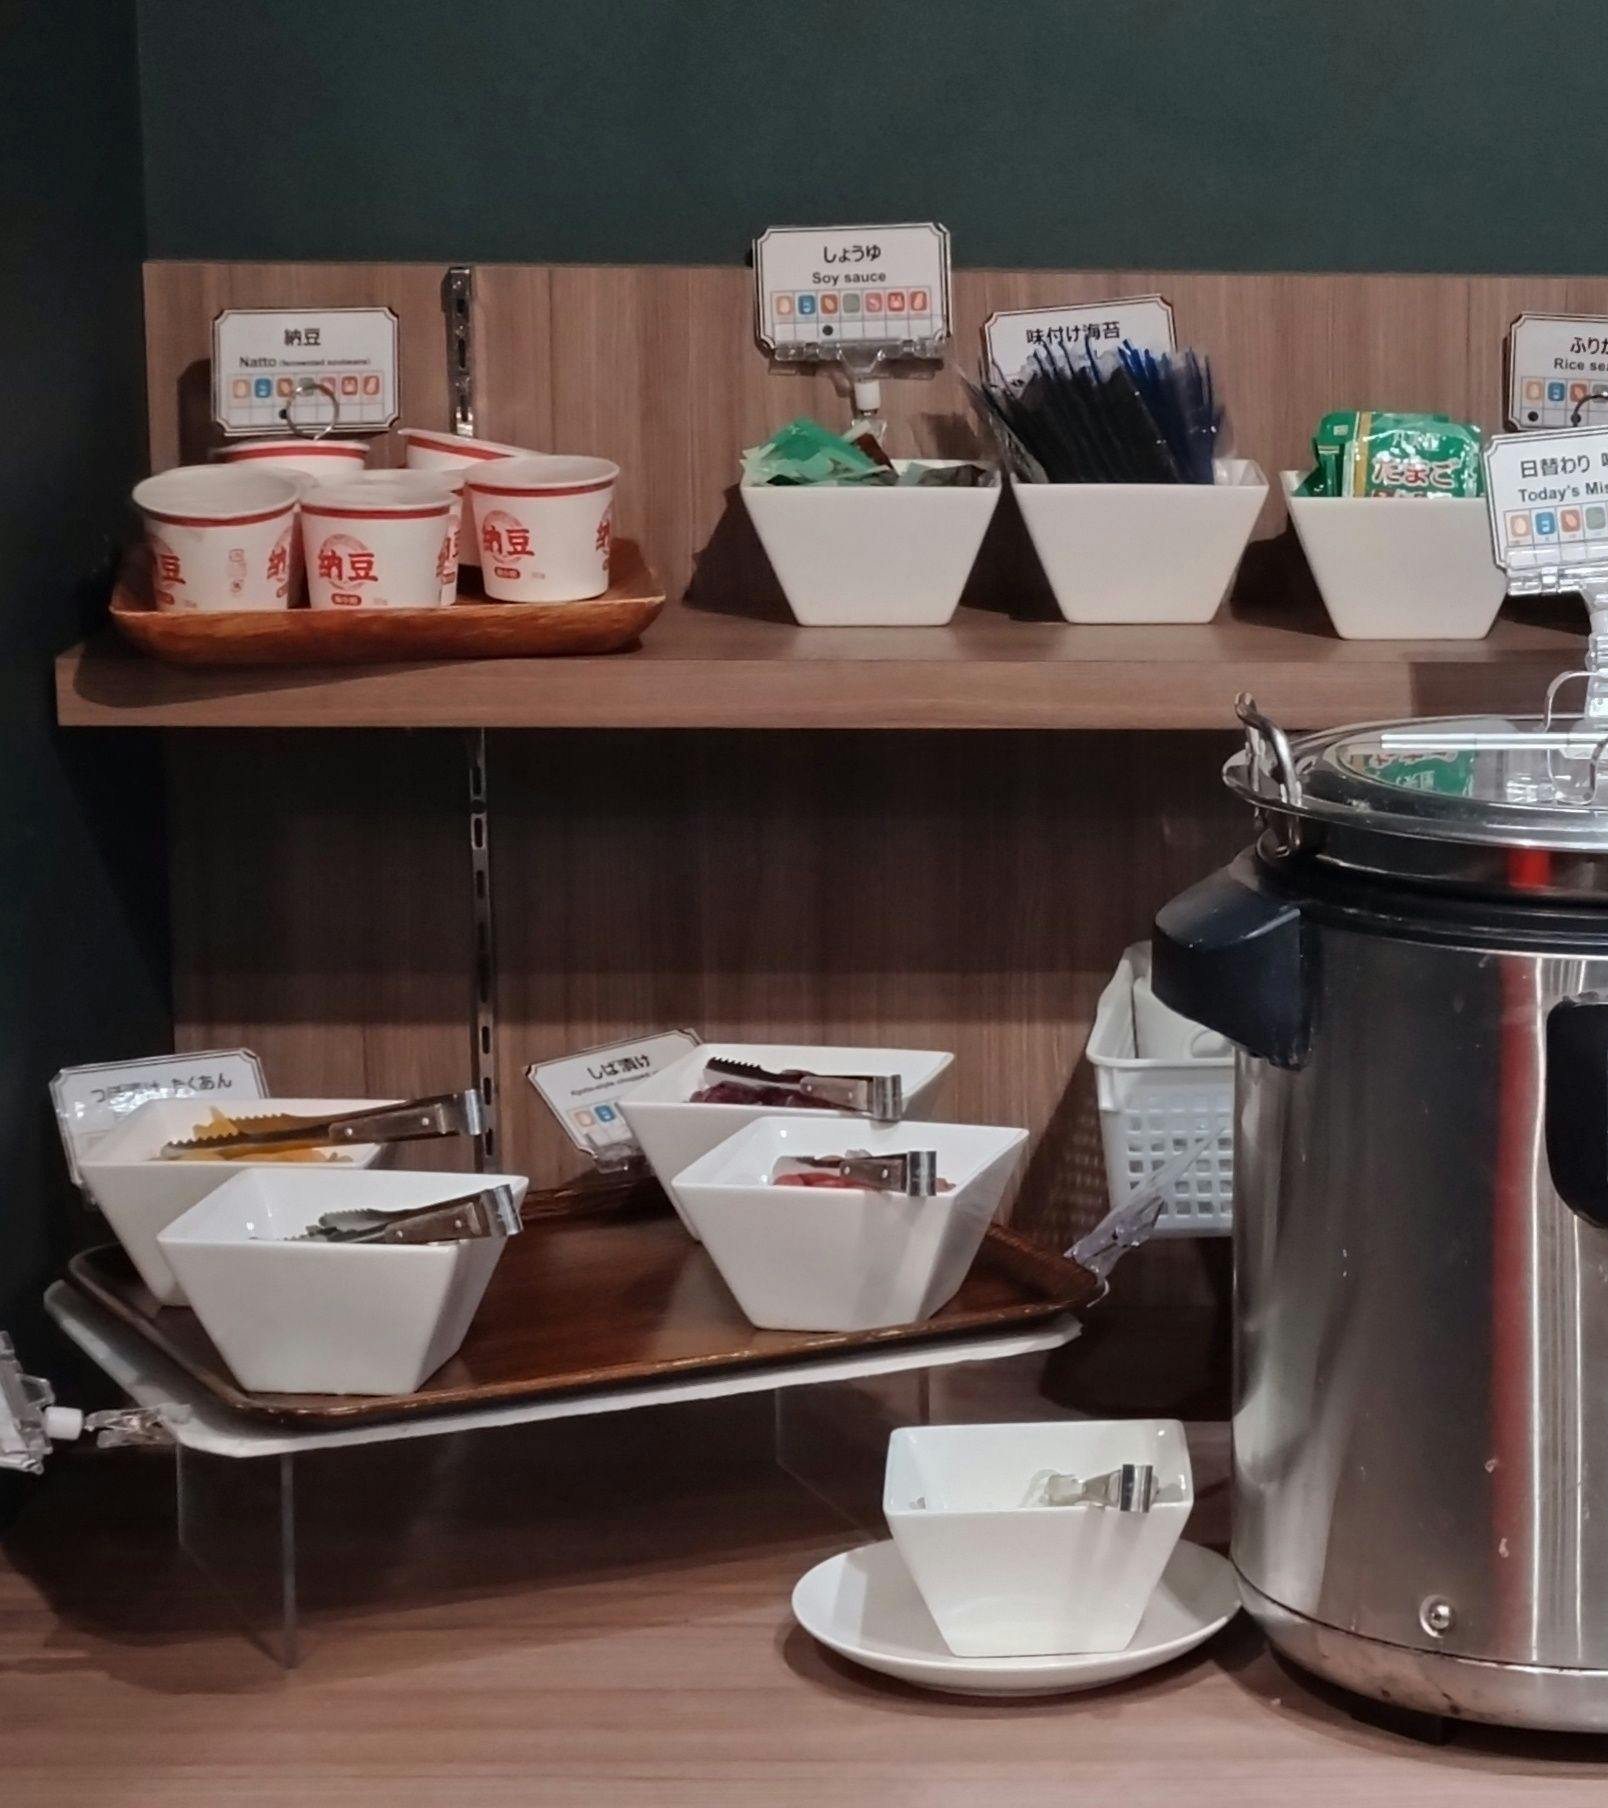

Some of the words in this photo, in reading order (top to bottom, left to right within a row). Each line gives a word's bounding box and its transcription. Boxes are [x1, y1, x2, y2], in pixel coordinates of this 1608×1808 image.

[823, 245, 882, 264] しょうゆ
[812, 272, 839, 285] Soy
[844, 271, 886, 284] sauce
[284, 328, 321, 346] 納豆
[1026, 321, 1120, 345] 味付け海苔
[239, 356, 277, 368] Natto
[1553, 358, 1585, 371] Rice
[1520, 454, 1590, 479] 日替わり
[1518, 484, 1581, 502] Today's
[483, 525, 535, 556] 納豆
[318, 549, 378, 582] 納豆
